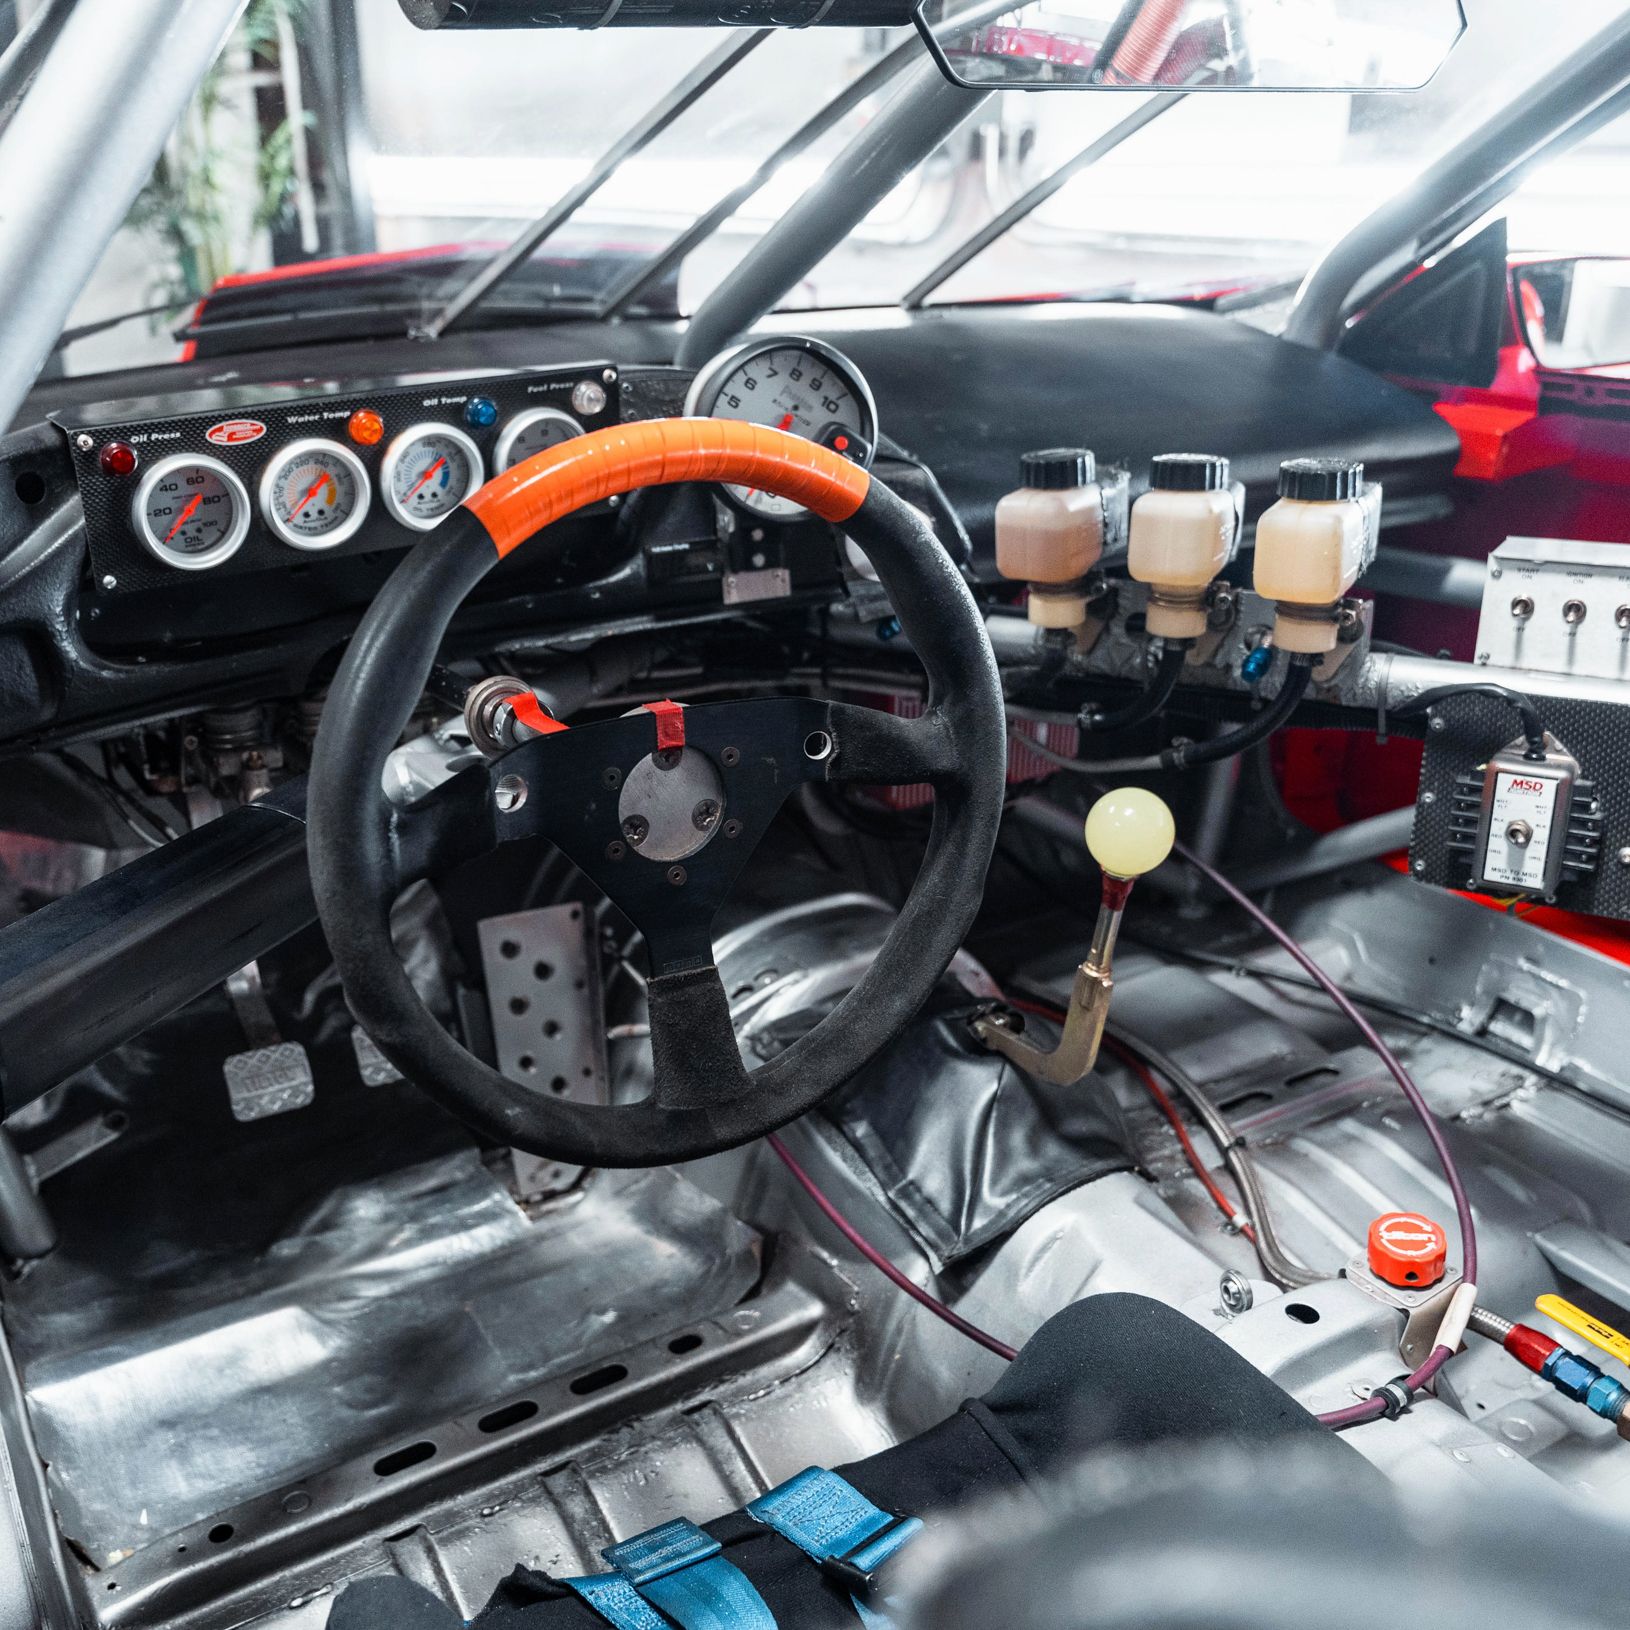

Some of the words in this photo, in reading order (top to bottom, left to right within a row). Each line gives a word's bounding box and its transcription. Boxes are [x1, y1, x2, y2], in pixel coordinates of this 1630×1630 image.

[766, 367, 779, 379] 7
[789, 367, 803, 382] 8
[744, 377, 758, 391] 6
[809, 377, 823, 392] 9
[422, 397, 438, 407] Oil
[440, 395, 467, 405] Temp
[727, 394, 741, 409] 5
[821, 395, 840, 414] 10
[287, 414, 320, 424] Water
[322, 410, 351, 420] Temp
[130, 434, 148, 444] Oil
[150, 431, 181, 441] Press
[186, 475, 205, 486] 60
[159, 483, 178, 492] 40
[203, 495, 222, 505] 80
[153, 506, 172, 517] 20
[184, 535, 204, 544] OIL
[1511, 779, 1544, 792] MSD
